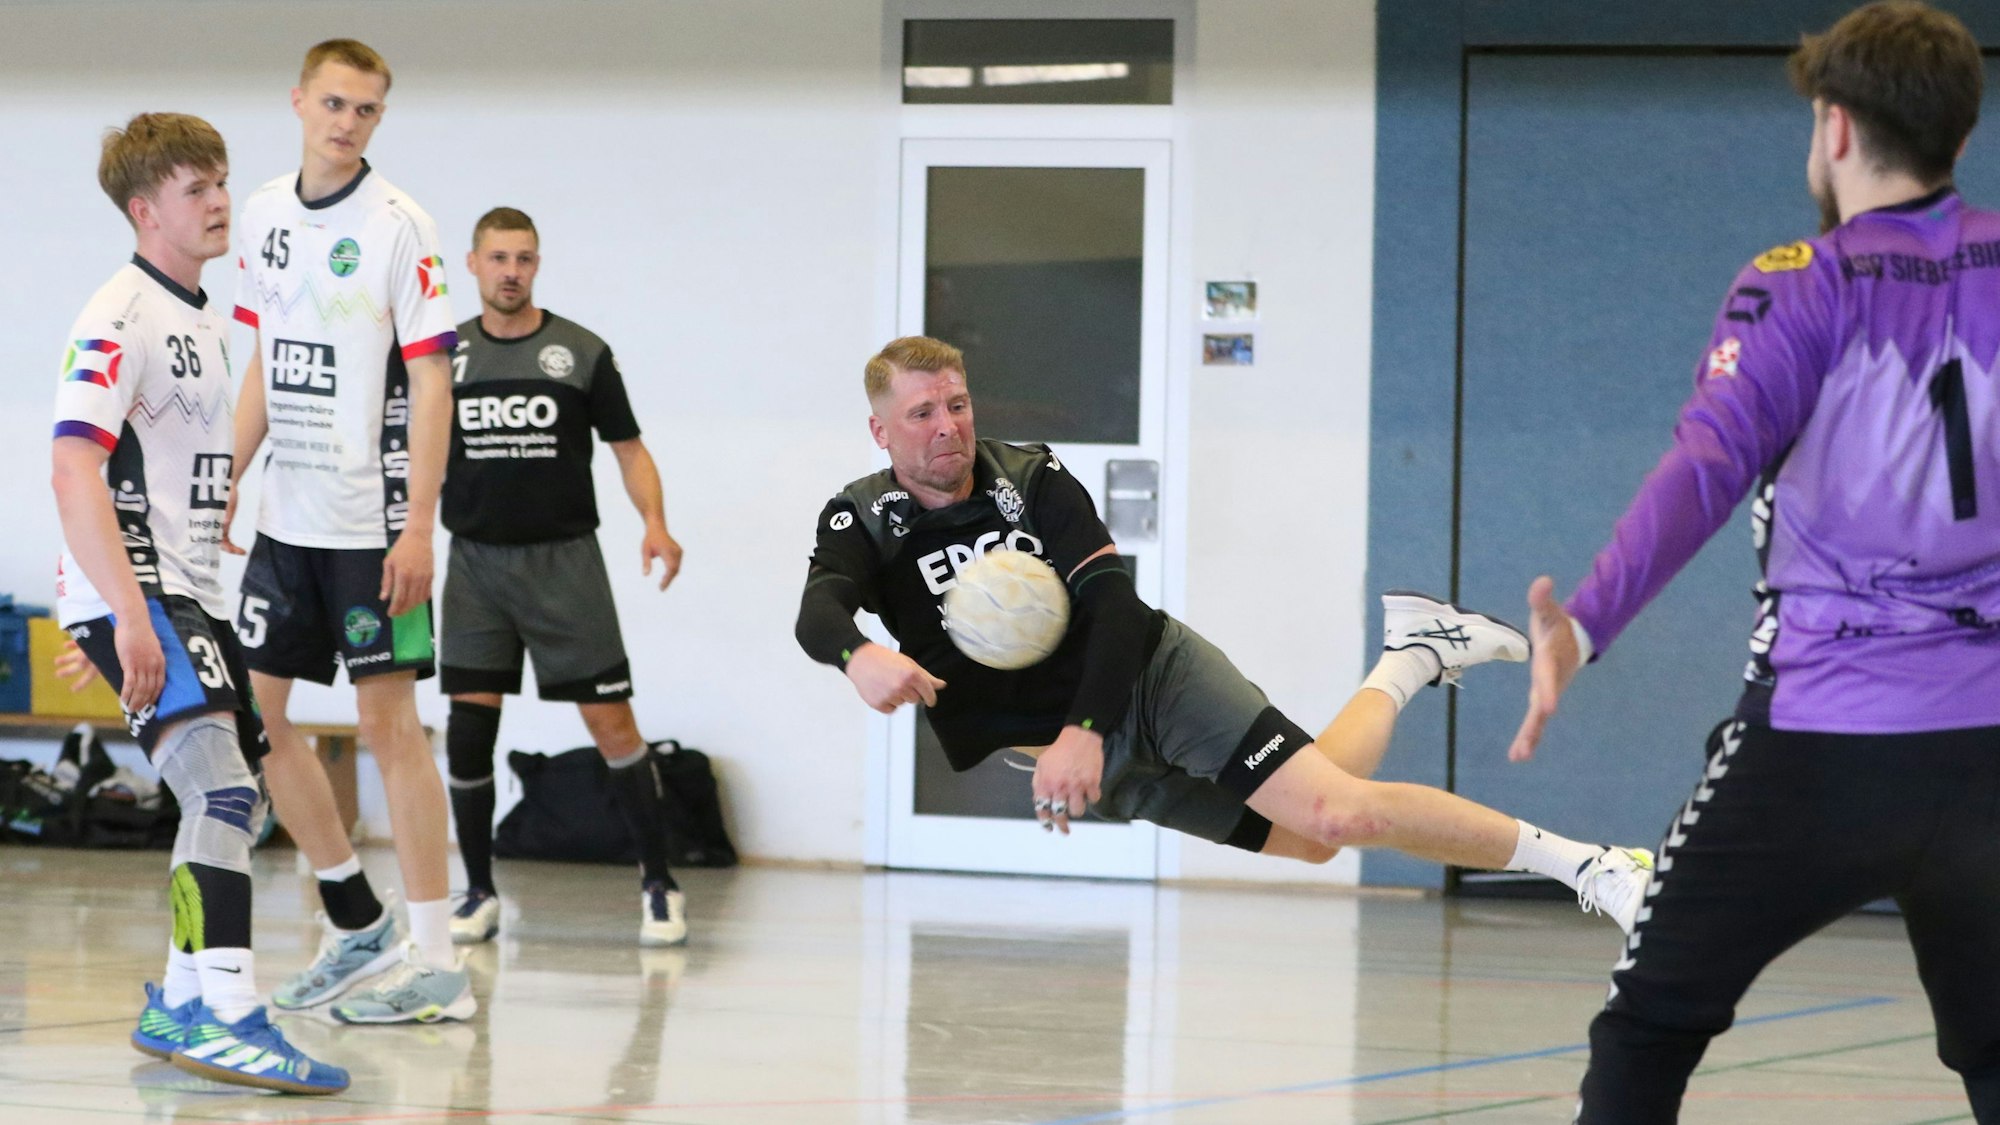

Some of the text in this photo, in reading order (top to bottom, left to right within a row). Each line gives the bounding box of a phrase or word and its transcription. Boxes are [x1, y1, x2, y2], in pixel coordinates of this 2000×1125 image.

[261, 227, 291, 270] 45
[166, 334, 202, 379] 36
[458, 394, 559, 431] ERGO
[510, 446, 520, 459] &
[1928, 357, 1977, 521] 1
[595, 680, 630, 695] Kempa
[1243, 733, 1286, 771] Kempa
